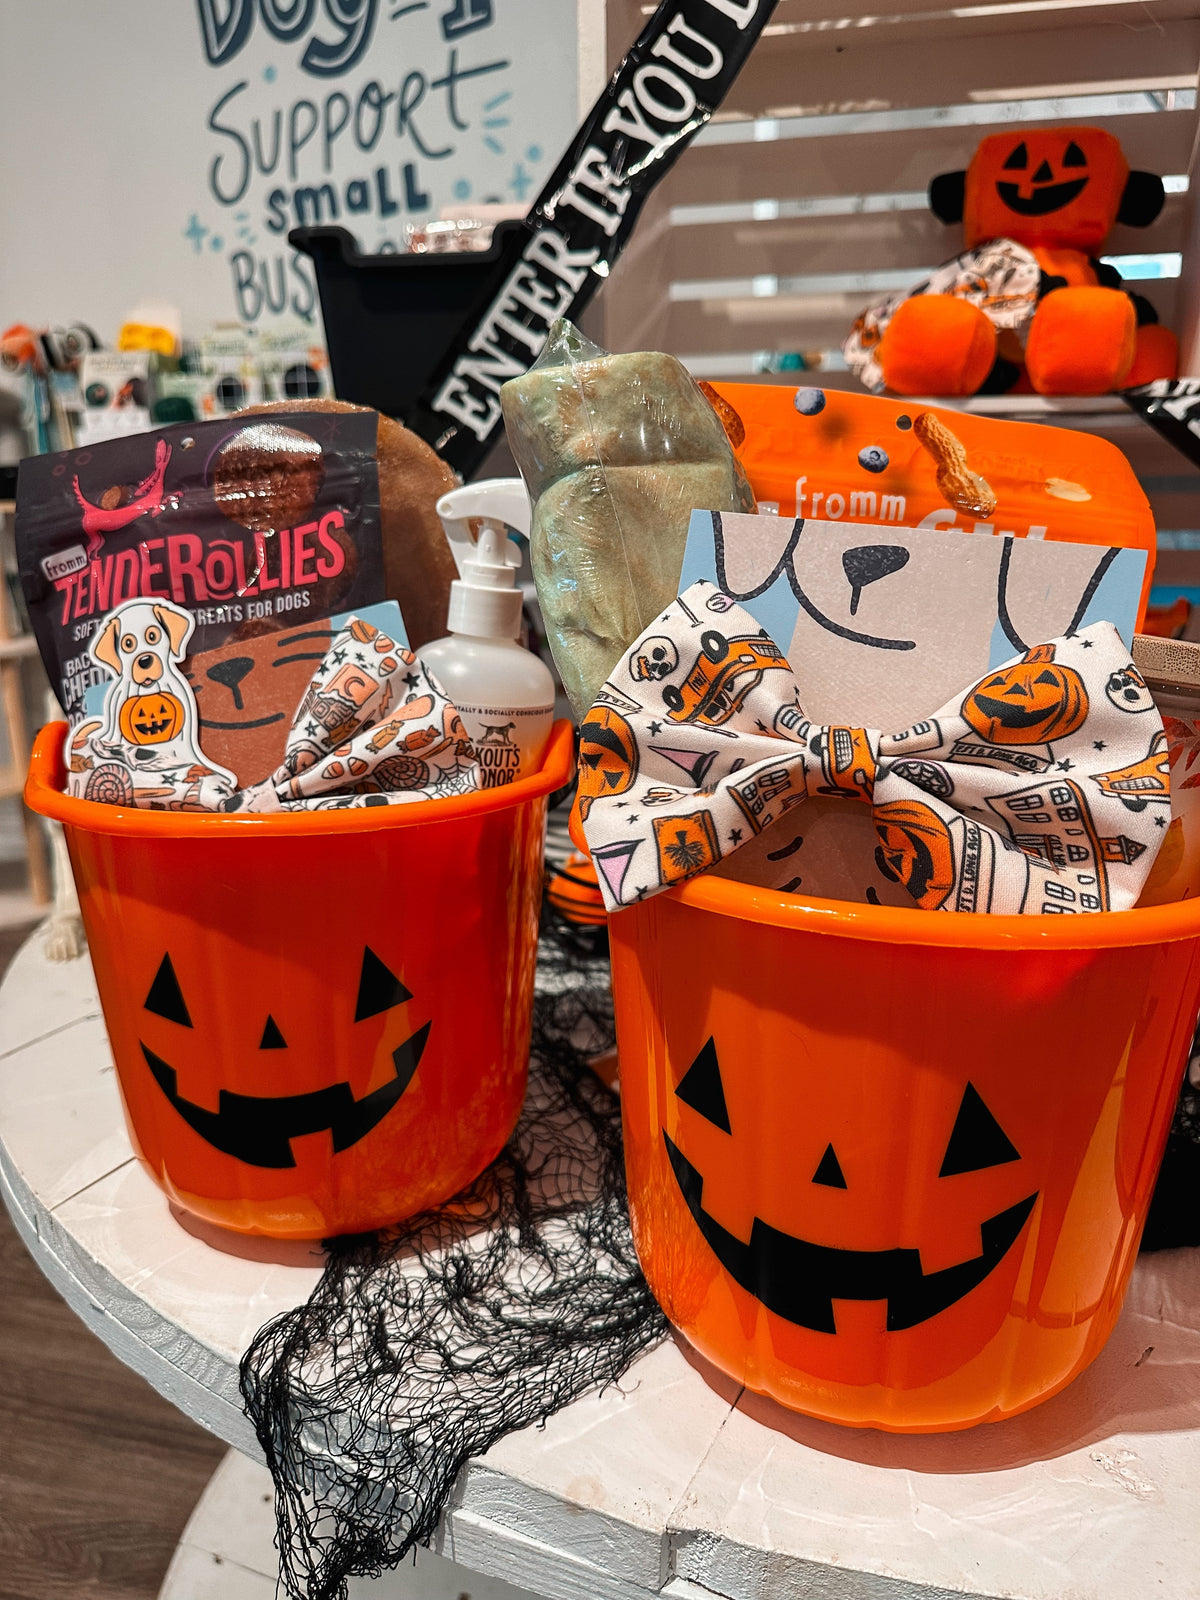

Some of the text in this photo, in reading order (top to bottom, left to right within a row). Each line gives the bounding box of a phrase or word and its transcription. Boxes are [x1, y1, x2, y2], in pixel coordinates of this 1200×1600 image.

[431, 12, 724, 442] ENTER IF YOU
[795, 476, 907, 521] fromm
[45, 554, 88, 577] fromm
[247, 600, 273, 620] FOR
[276, 591, 311, 613] DOGS
[66, 653, 91, 677] BAC
[475, 744, 520, 768] KOUT'S
[481, 768, 515, 788] ONOR
